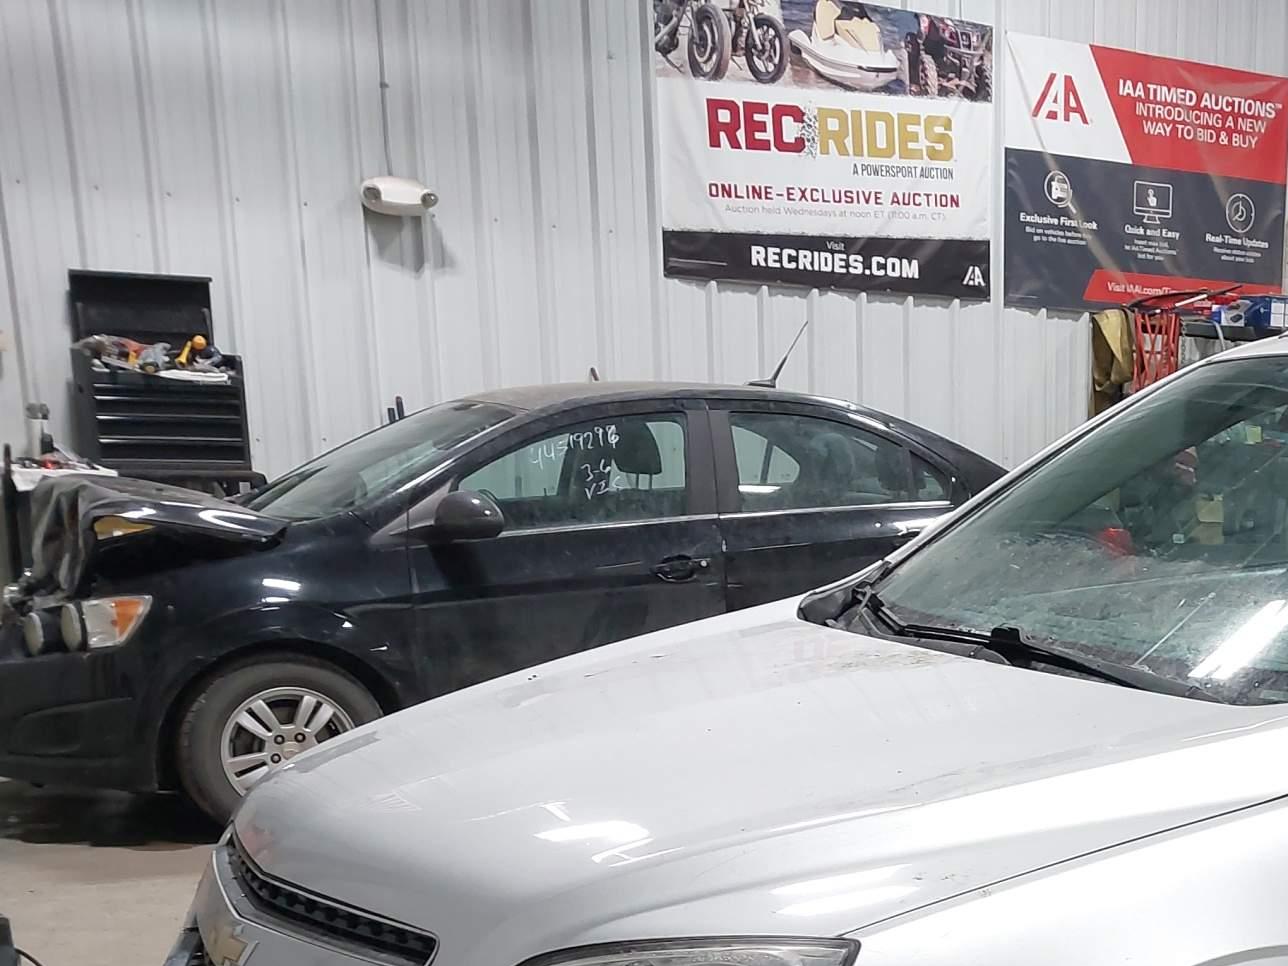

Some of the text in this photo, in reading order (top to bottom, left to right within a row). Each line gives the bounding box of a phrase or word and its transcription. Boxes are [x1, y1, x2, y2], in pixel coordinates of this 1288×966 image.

[1118, 78, 1145, 99] IAA
[1147, 84, 1197, 106] TIMED
[1135, 101, 1267, 133] INTRODUCING A NEW
[706, 97, 954, 162] REC RIDES
[1142, 120, 1258, 149] WAY TO BID & BUY
[852, 163, 954, 180] A POWERSPORT AUCTION
[708, 182, 961, 208] ONLINE-EXCLUSIVE AUCTION
[724, 203, 759, 214] Auction
[761, 205, 781, 215] held
[783, 206, 837, 218] Wednesdays
[850, 210, 872, 218] noon
[874, 210, 885, 219] ET
[1020, 212, 1059, 225] Exclusive
[1079, 219, 1098, 230] Look
[1124, 224, 1180, 240] Quick and Easy
[1205, 232, 1242, 246] Real-Time
[825, 241, 845, 251] Visit
[750, 245, 920, 279] RECRIDES.COM
[1107, 281, 1126, 292] Visit
